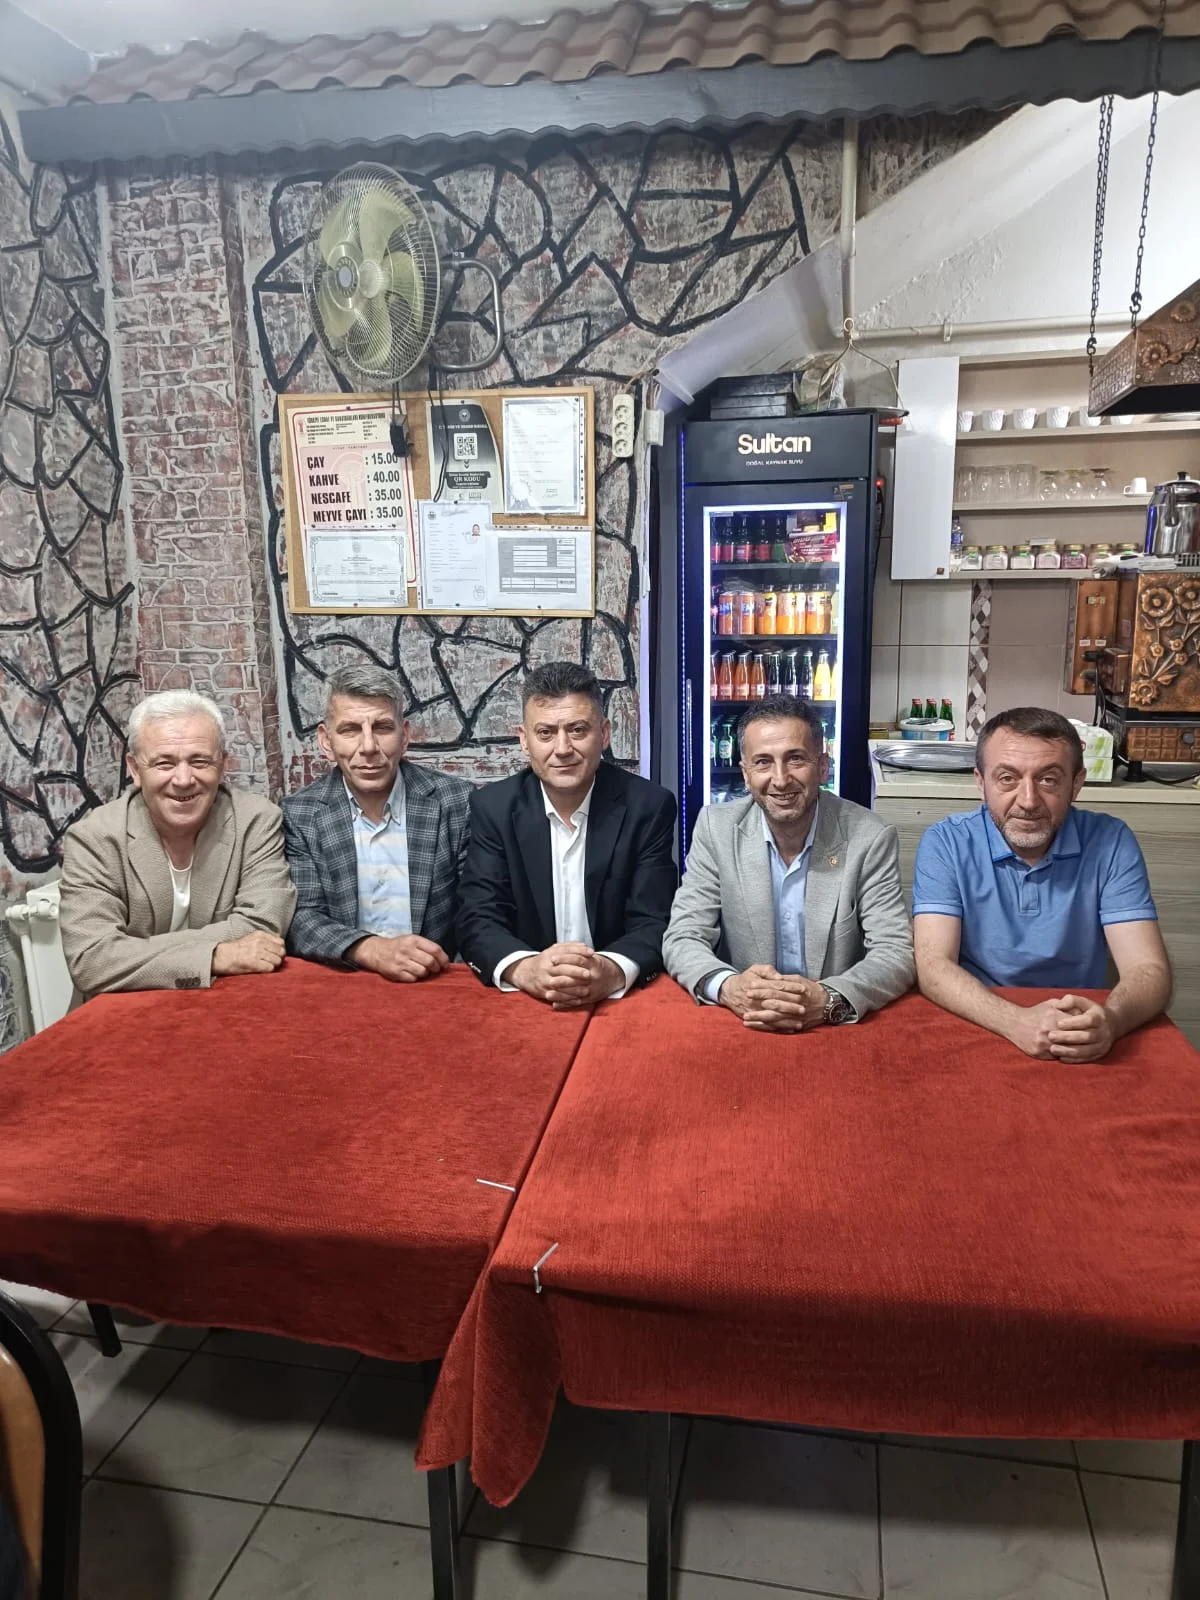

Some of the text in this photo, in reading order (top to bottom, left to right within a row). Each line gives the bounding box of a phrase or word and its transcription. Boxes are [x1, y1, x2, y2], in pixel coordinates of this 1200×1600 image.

[738, 432, 812, 455] Sultan
[306, 456, 325, 470] ÇAY
[371, 452, 398, 465] 15.00
[309, 473, 340, 487] KAHVE
[372, 470, 400, 483] 40.00
[311, 491, 352, 505] NESCAFE
[374, 488, 402, 501] 35.00
[313, 509, 343, 523] MEYVE
[345, 508, 367, 523] ÇAYI
[376, 506, 403, 519] 35.00
